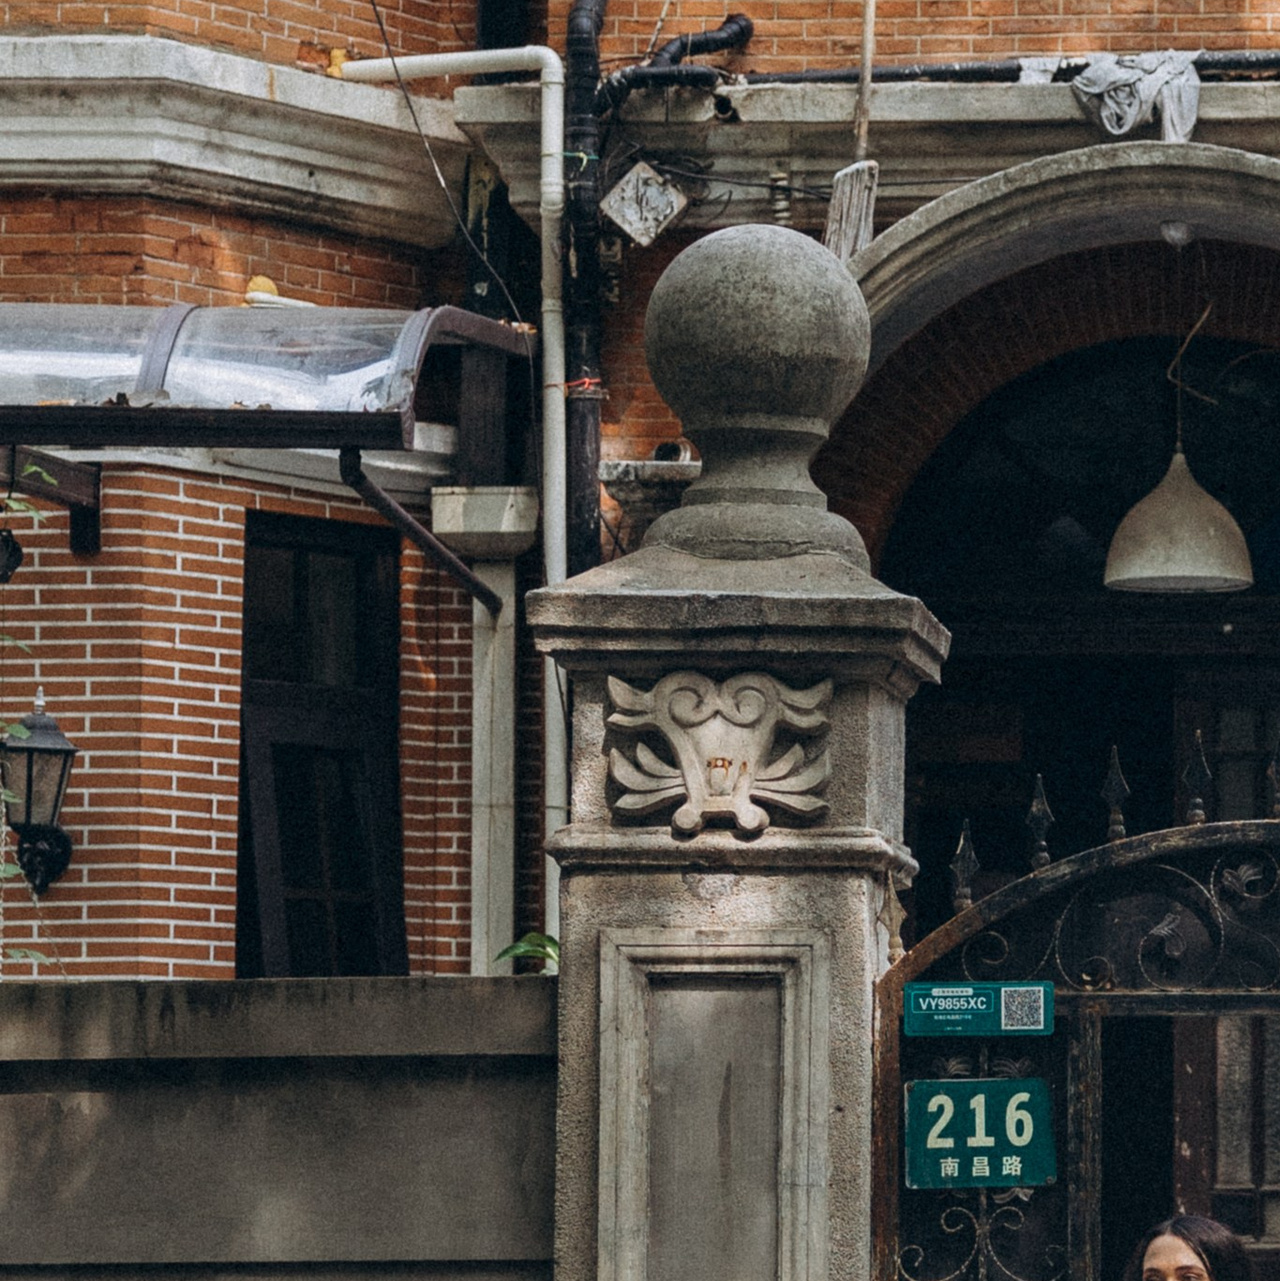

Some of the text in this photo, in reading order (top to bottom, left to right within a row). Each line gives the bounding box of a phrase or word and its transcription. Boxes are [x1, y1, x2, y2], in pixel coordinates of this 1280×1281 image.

[919, 997, 987, 1010] VY9855XC
[926, 1092, 1034, 1149] 216
[940, 1156, 1022, 1177] 南昌路
